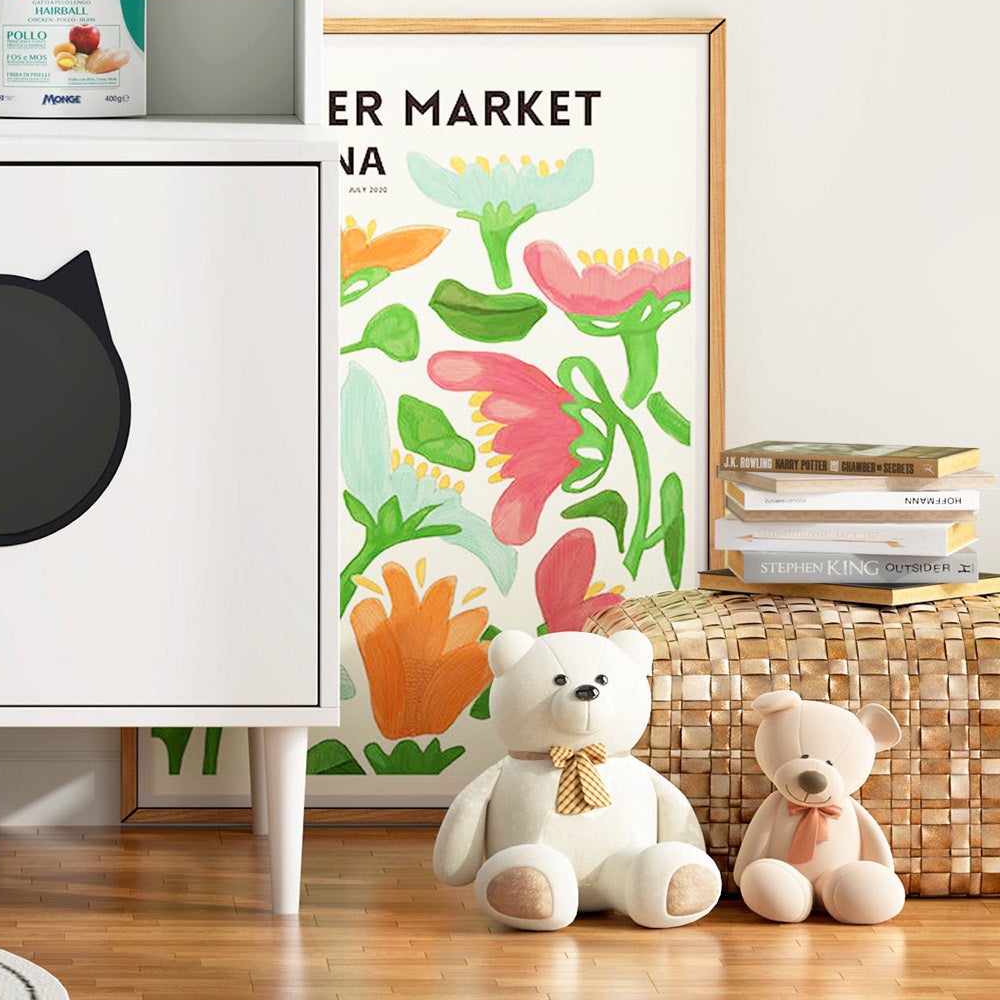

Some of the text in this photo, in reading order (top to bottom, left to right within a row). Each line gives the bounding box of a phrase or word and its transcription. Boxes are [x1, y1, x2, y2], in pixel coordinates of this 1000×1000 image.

[35, 6, 88, 15] HAIRBALL
[7, 31, 47, 40] POLLO
[328, 89, 601, 126] ER MARKET
[723, 456, 738, 468] J.K.
[740, 457, 772, 469] ROWLING
[775, 459, 799, 471] HARRY
[800, 459, 827, 471] POTTER
[841, 460, 876, 473] CHAMBER
[883, 462, 914, 474] SECRETS
[904, 496, 962, 505] HOFFMANN
[760, 560, 824, 574] STEPHEN
[826, 560, 879, 576] KING
[885, 562, 951, 574] OUTSIDER
